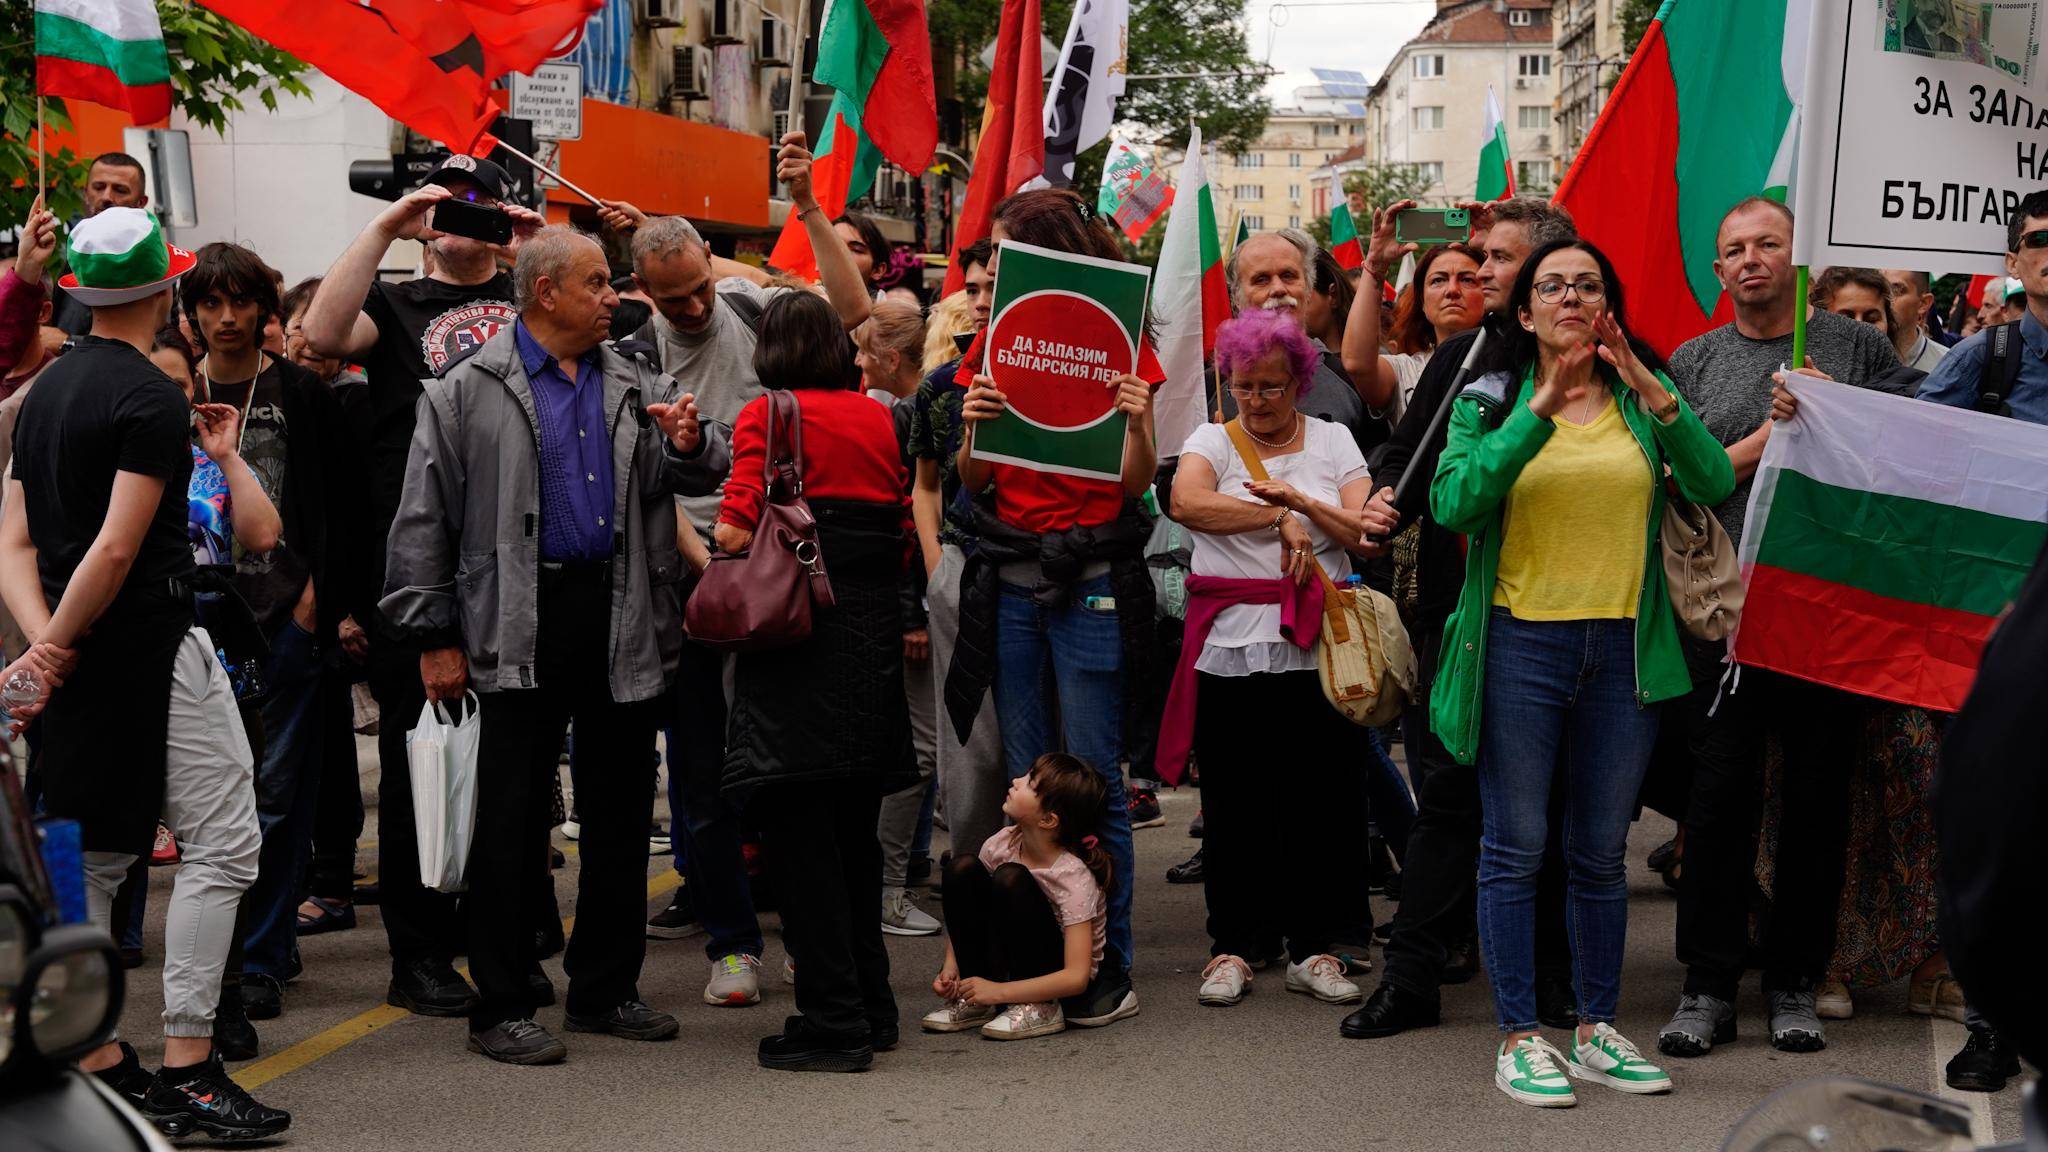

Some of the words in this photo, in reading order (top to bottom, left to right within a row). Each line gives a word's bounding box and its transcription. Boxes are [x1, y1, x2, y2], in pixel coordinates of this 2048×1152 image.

[1914, 76, 1953, 118] ЗА
[488, 307, 500, 315] на
[997, 348, 1089, 380] БЪЛГАРСКИЯ
[1012, 335, 1033, 353] ДА
[1036, 339, 1108, 366] ЗАПАЗИМ
